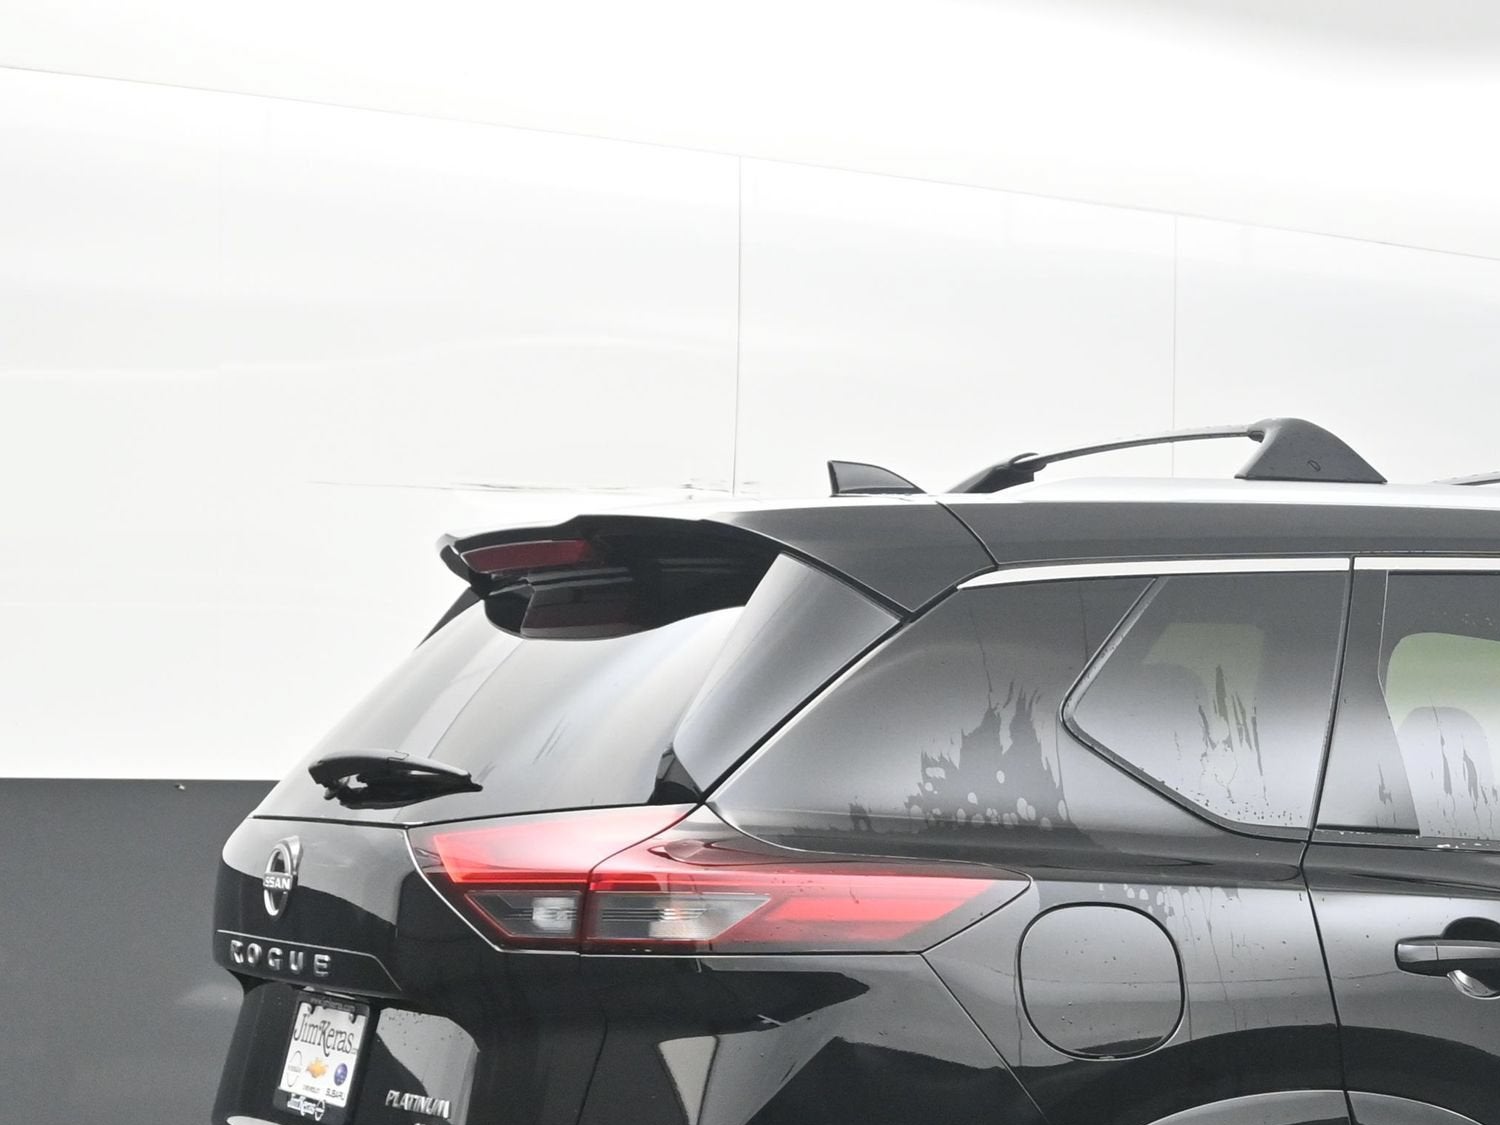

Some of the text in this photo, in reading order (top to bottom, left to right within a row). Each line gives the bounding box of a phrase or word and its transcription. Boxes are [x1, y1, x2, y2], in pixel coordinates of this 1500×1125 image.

[264, 876, 290, 889] SSAN
[230, 939, 331, 977] ROGUE
[385, 1089, 450, 1119] PLATINUM
